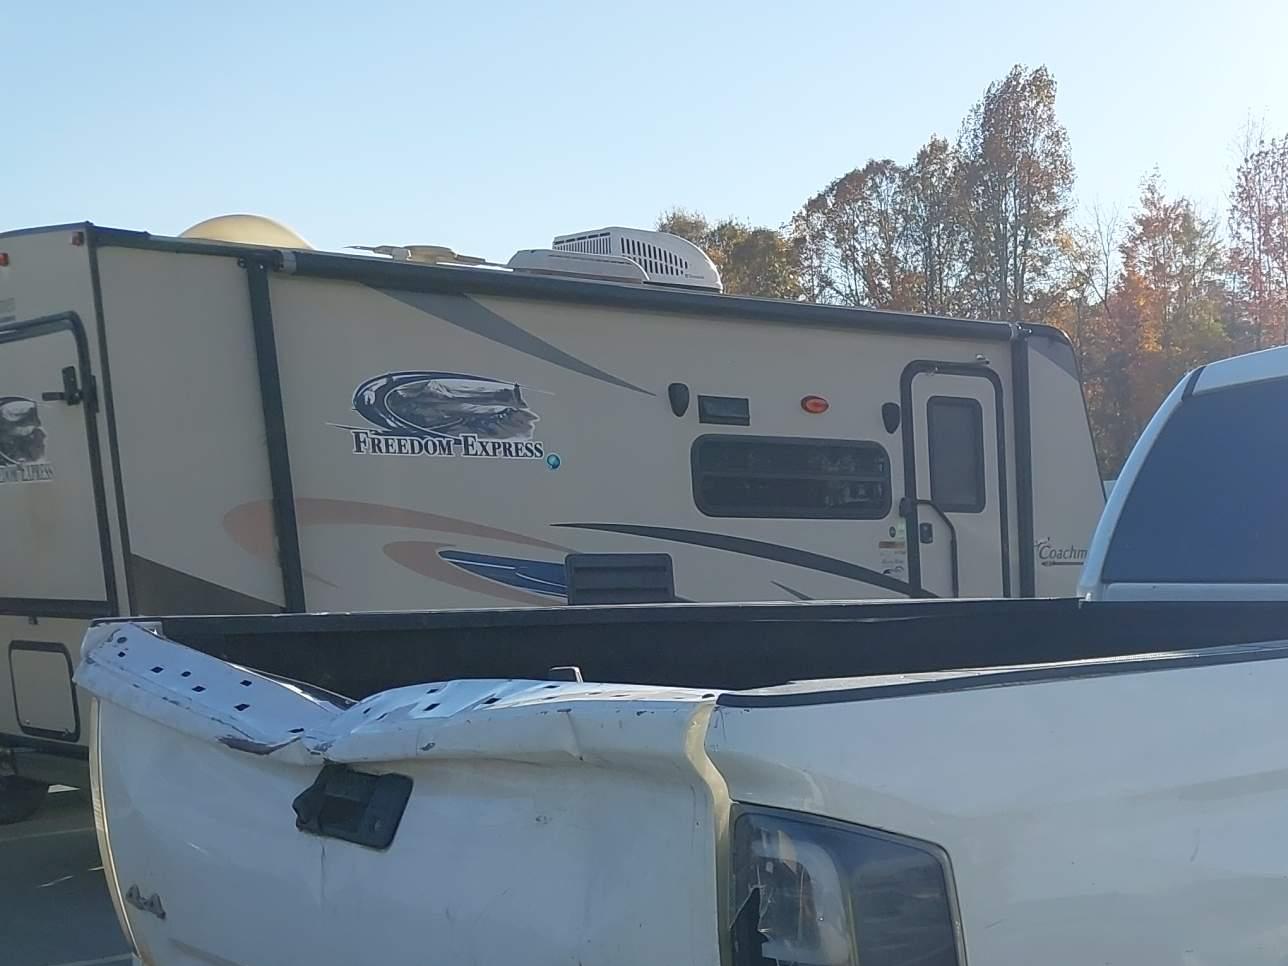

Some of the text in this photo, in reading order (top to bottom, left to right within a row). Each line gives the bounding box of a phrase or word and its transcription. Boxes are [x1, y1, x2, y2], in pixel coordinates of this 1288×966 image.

[352, 431, 544, 458] FREEDOM EXPRESS
[1039, 544, 1088, 560] Coachm
